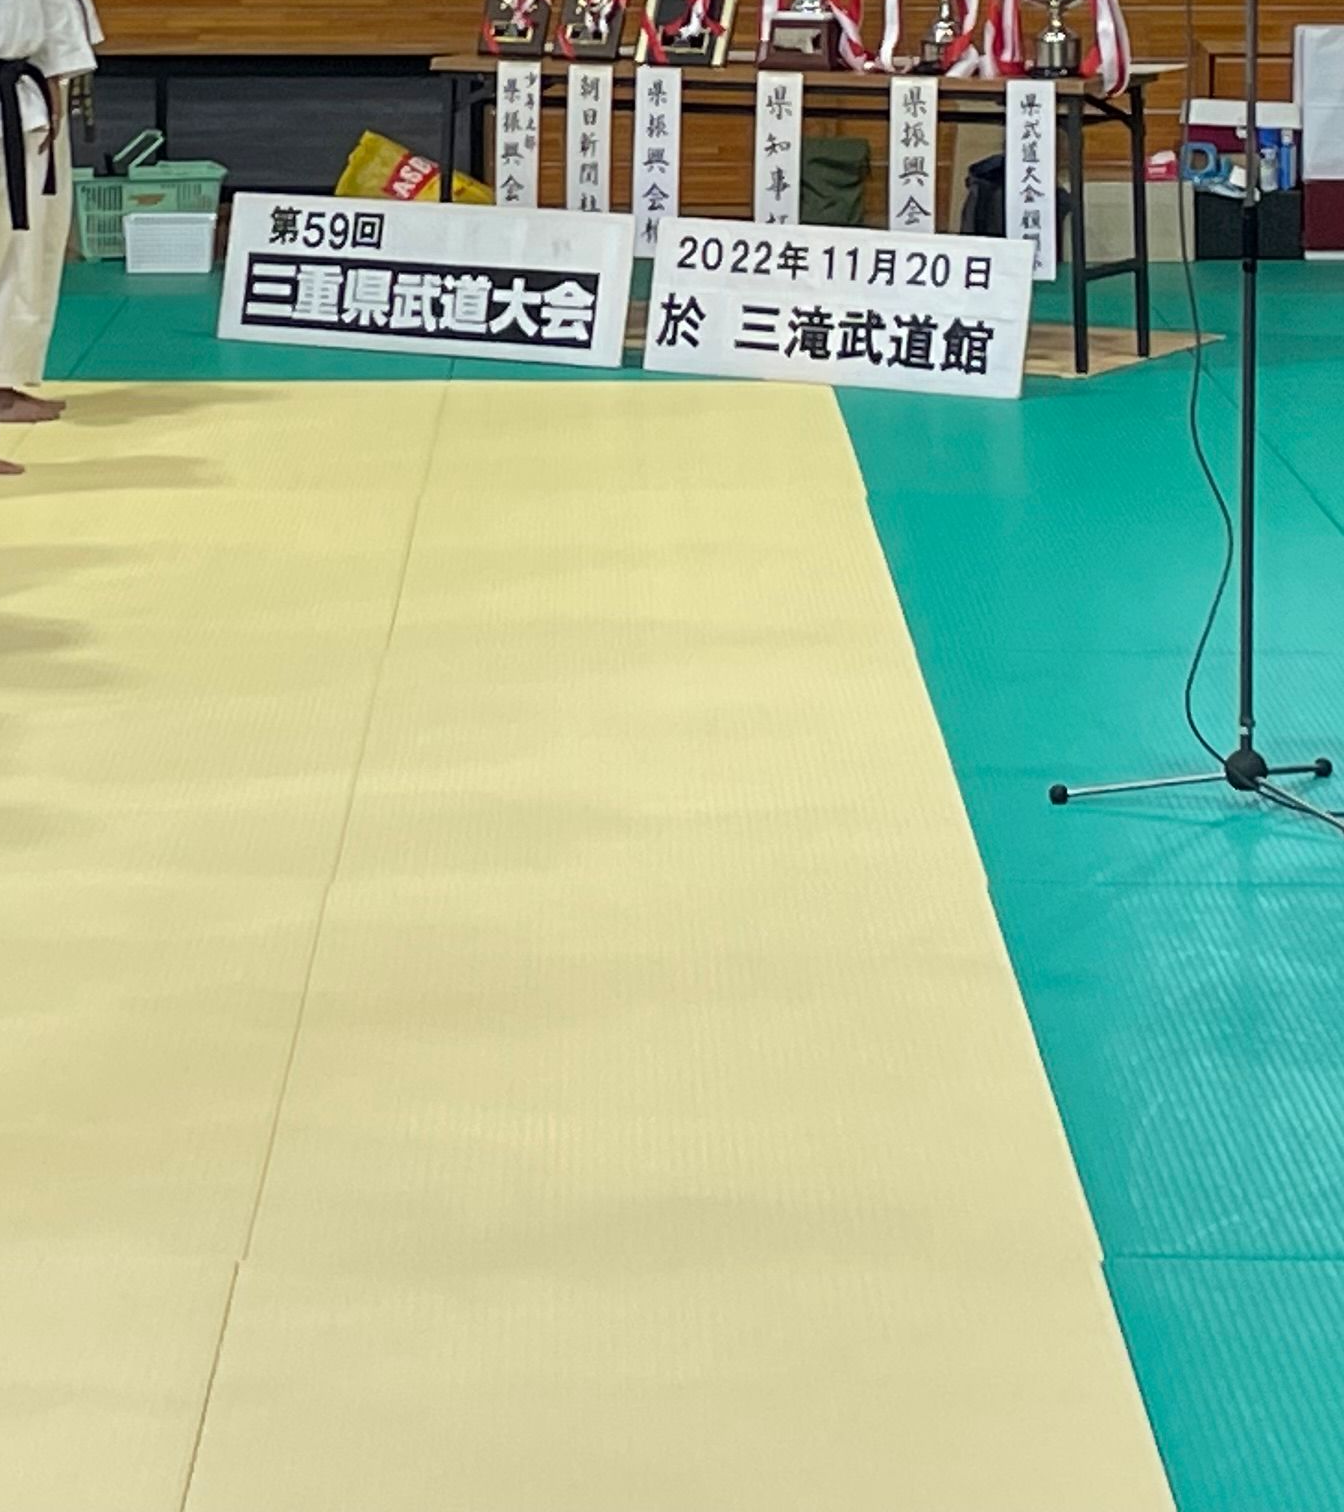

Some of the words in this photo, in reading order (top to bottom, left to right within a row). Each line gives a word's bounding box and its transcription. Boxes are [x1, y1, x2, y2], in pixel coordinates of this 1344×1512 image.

[895, 86, 931, 226] 県振興会
[269, 205, 385, 250] 第59回
[676, 236, 992, 290] 2022年11月20日
[245, 263, 595, 342] 三重県武道大会
[656, 292, 707, 348] 於
[734, 304, 995, 376] 三滝武道館
